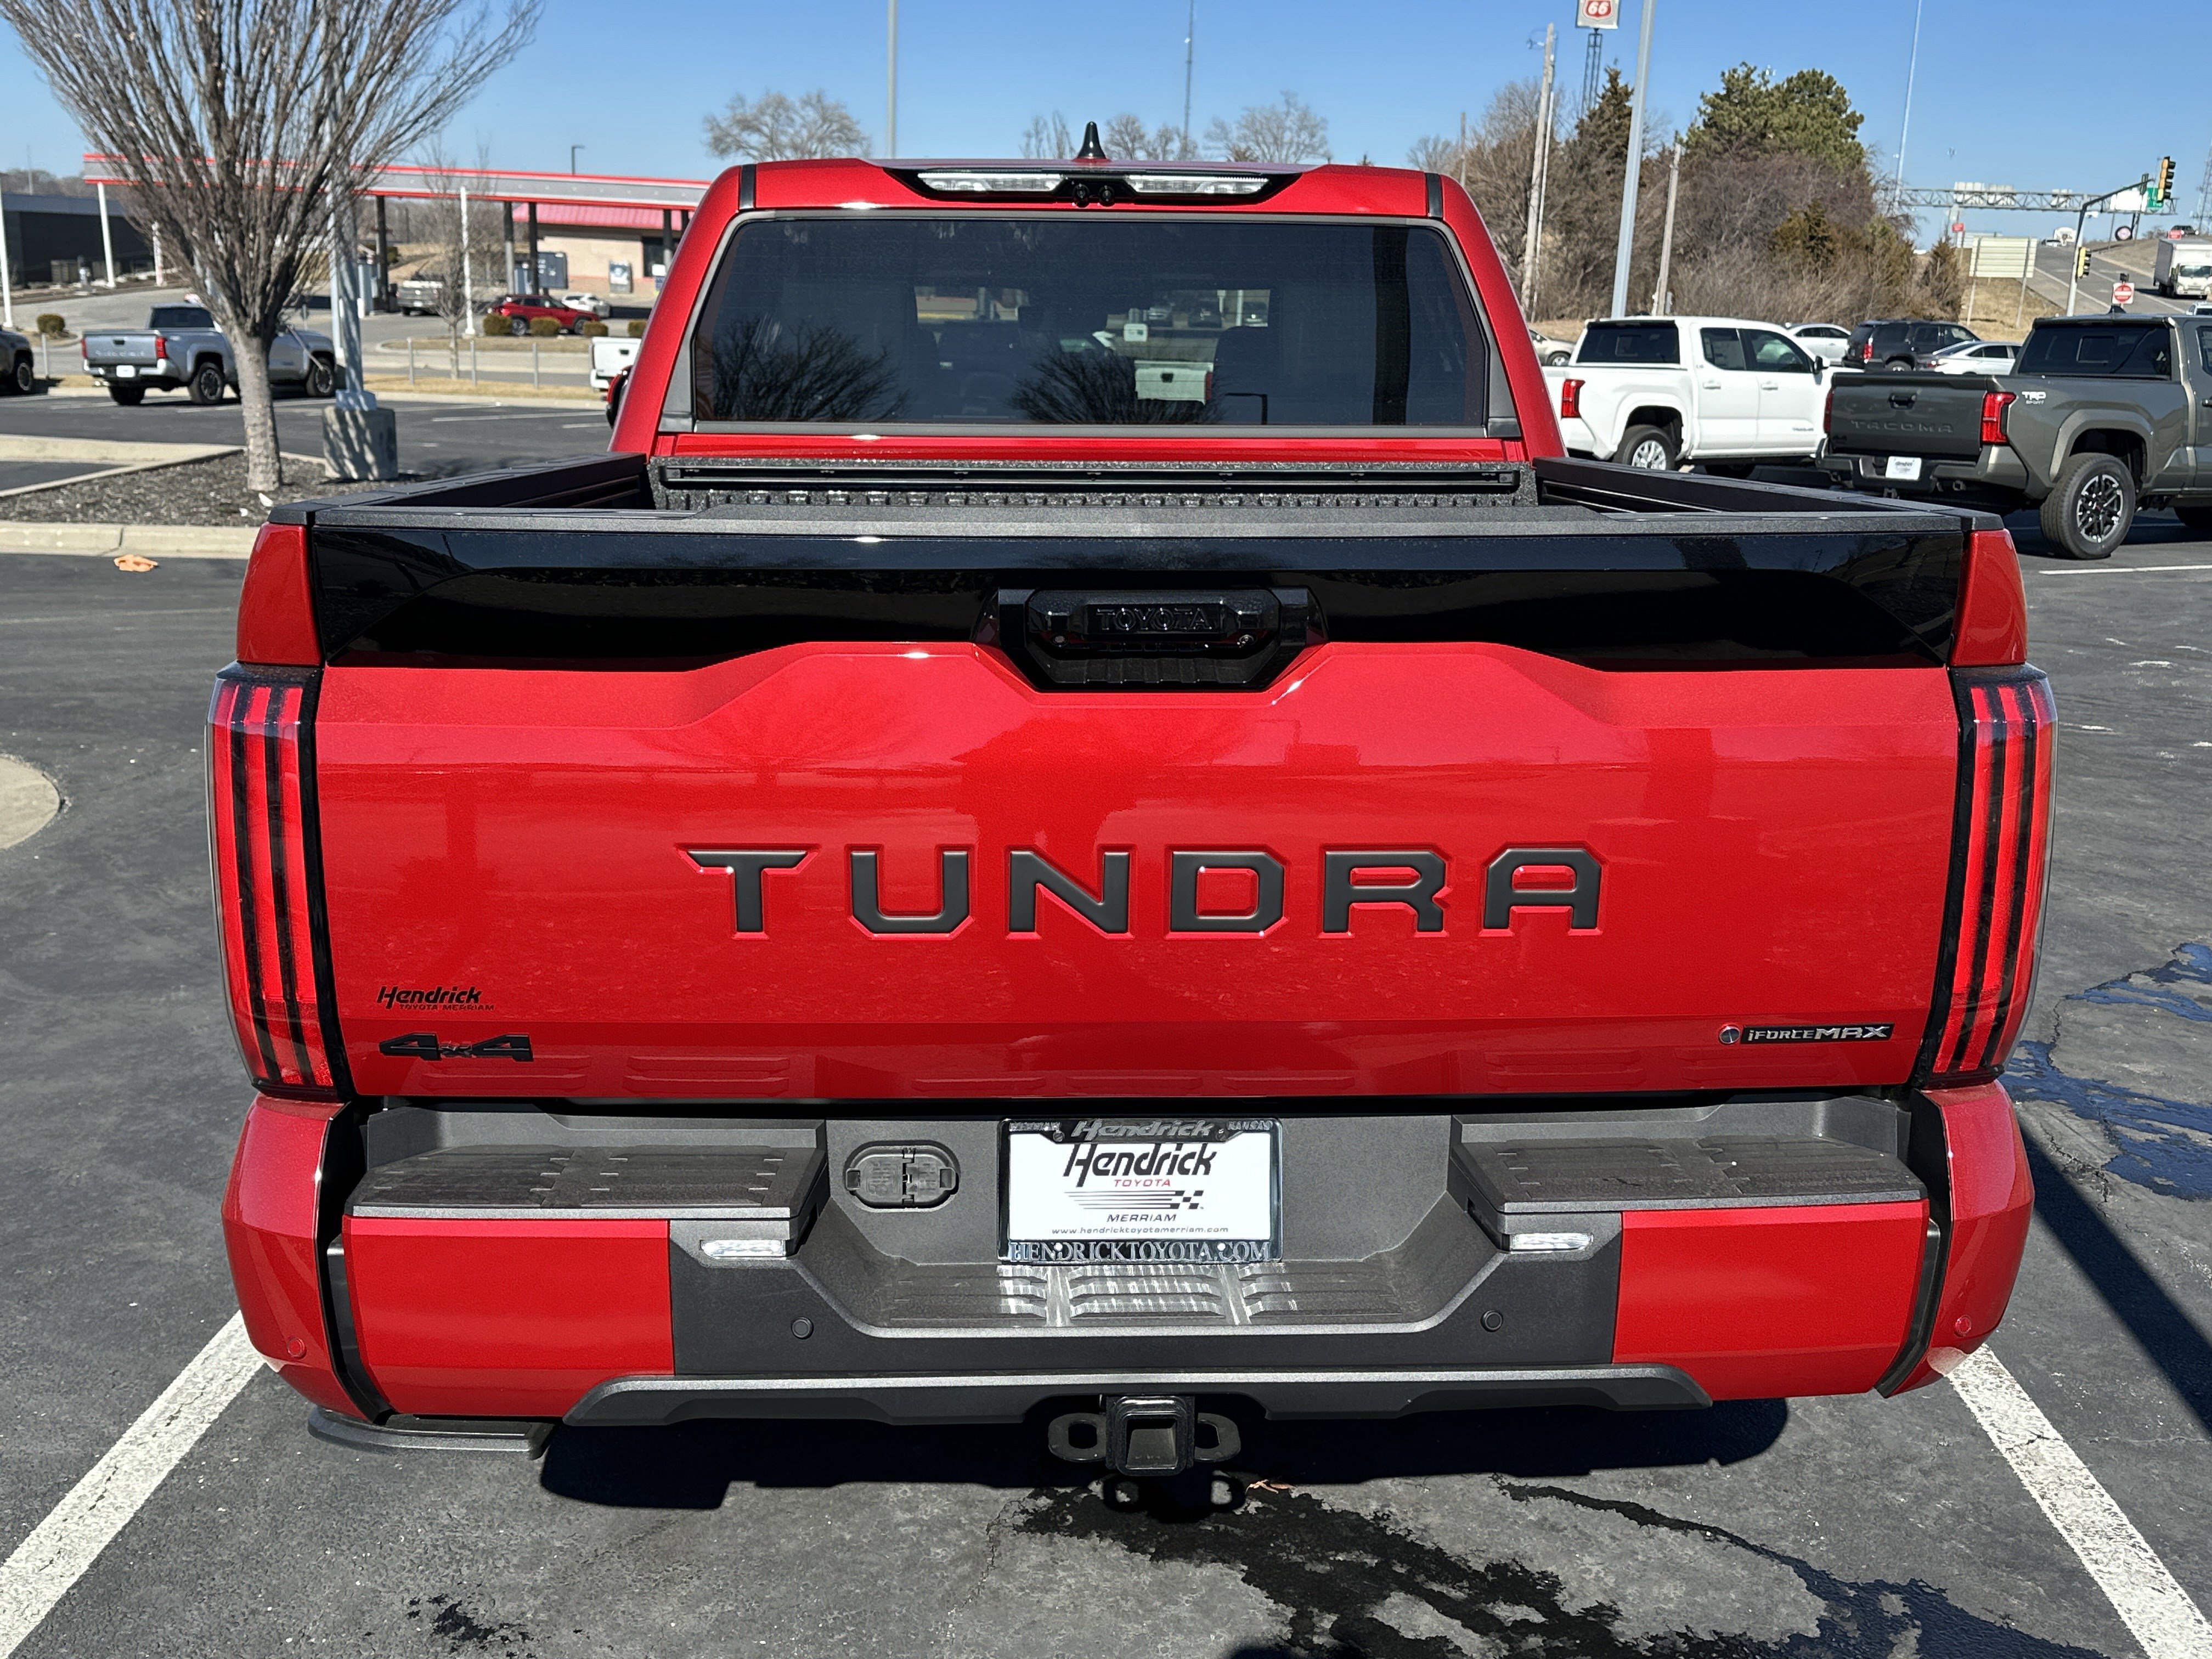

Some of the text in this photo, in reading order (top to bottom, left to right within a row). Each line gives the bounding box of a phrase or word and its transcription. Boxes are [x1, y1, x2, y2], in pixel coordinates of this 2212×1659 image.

[1588, 1, 1609, 15] 66
[2022, 391, 2046, 400] TRD
[1850, 419, 1955, 433] TACOMA
[1097, 607, 1212, 630] TOYOTA
[684, 846, 1605, 939] TUNDRA
[376, 985, 482, 1010] Hendrick
[1071, 1119, 1215, 1141] Hendrick
[1227, 1120, 1273, 1131] KANSAS
[1063, 1143, 1217, 1188] Hendrick
[1114, 1178, 1171, 1187] TOYOTA
[1107, 1214, 1177, 1223] MERRIAM
[1051, 1226, 1229, 1234] www.hendricktoyotamerriam.com
[1009, 1240, 1271, 1261] HENDRICKTOYOTA.COM
